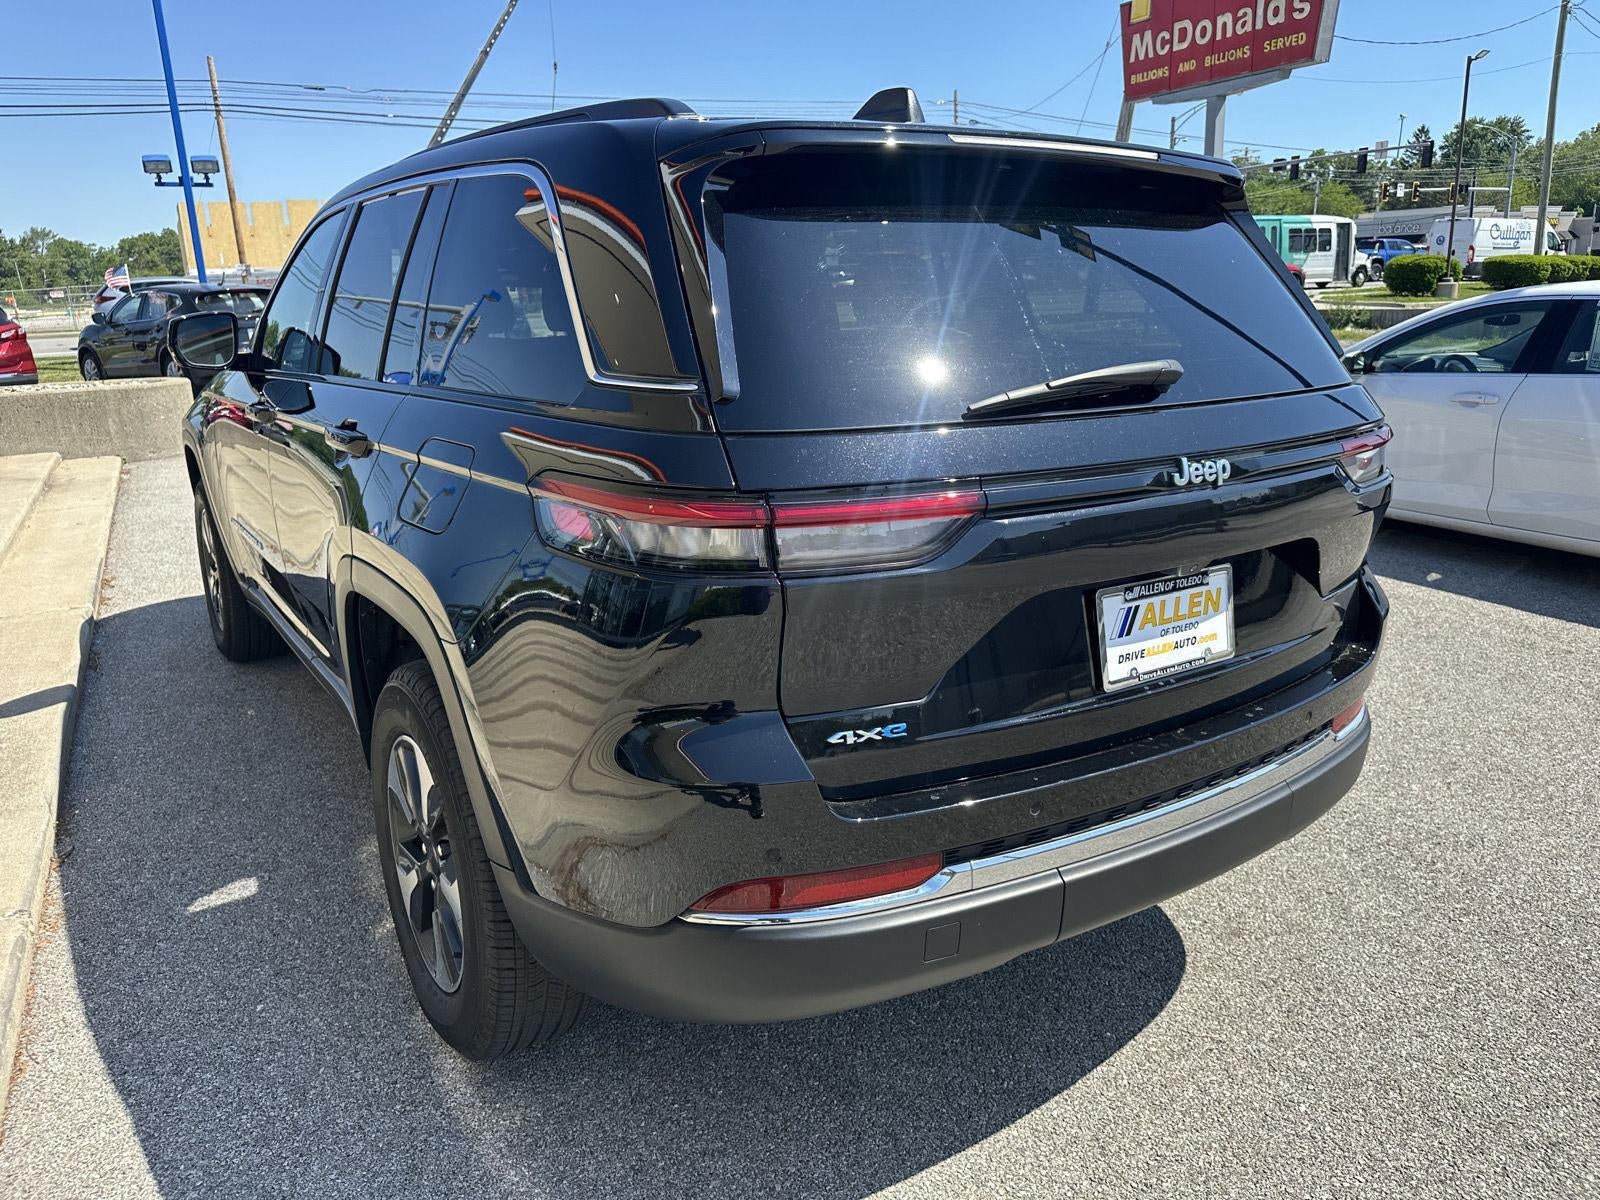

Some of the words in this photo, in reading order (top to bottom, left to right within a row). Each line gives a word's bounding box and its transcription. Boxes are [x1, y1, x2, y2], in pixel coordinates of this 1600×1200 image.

[1129, 0, 1311, 63] McDonalds
[1130, 66, 1169, 85] BILLIONS
[1177, 59, 1196, 74] AND
[1204, 46, 1250, 67] BILLIONS
[1263, 32, 1306, 53] SERVED
[1378, 218, 1420, 234] baance
[1171, 456, 1231, 486] Jeep
[1140, 582, 1165, 597] ALLEN
[1165, 581, 1175, 591] OF
[1176, 575, 1202, 589] TOLEDO
[1138, 587, 1222, 631] ALLEN
[1160, 628, 1172, 638] OF
[1172, 621, 1199, 635] TOLEDO
